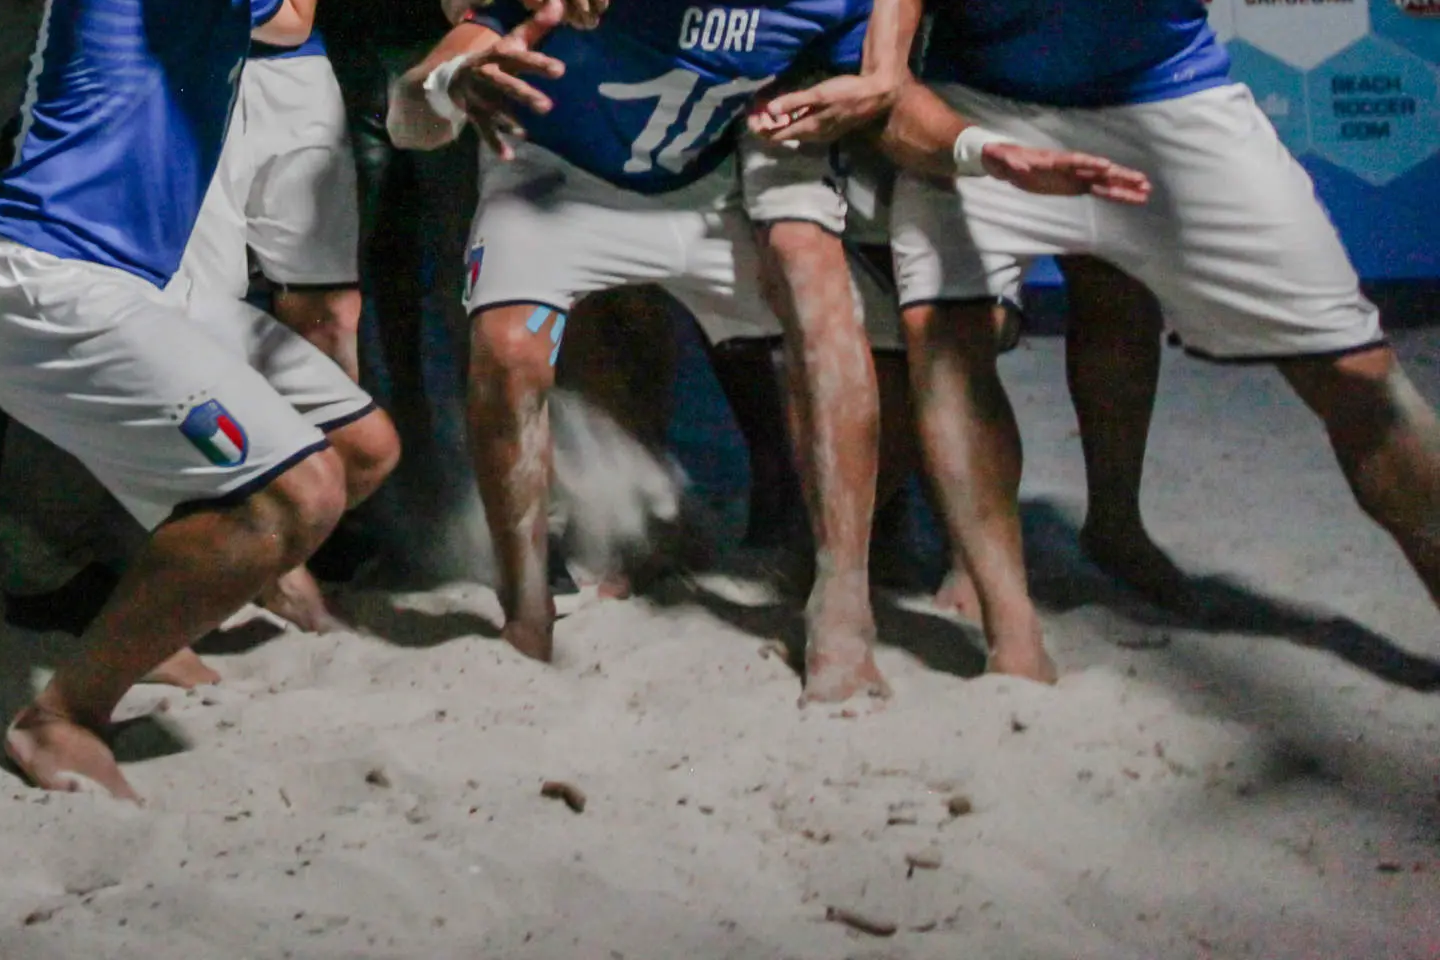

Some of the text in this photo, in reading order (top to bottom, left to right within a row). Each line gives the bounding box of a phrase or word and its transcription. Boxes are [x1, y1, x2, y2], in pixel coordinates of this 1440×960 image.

[678, 7, 760, 53] GORI
[1331, 75, 1402, 95] BEACH
[1332, 97, 1417, 117] SOCCER
